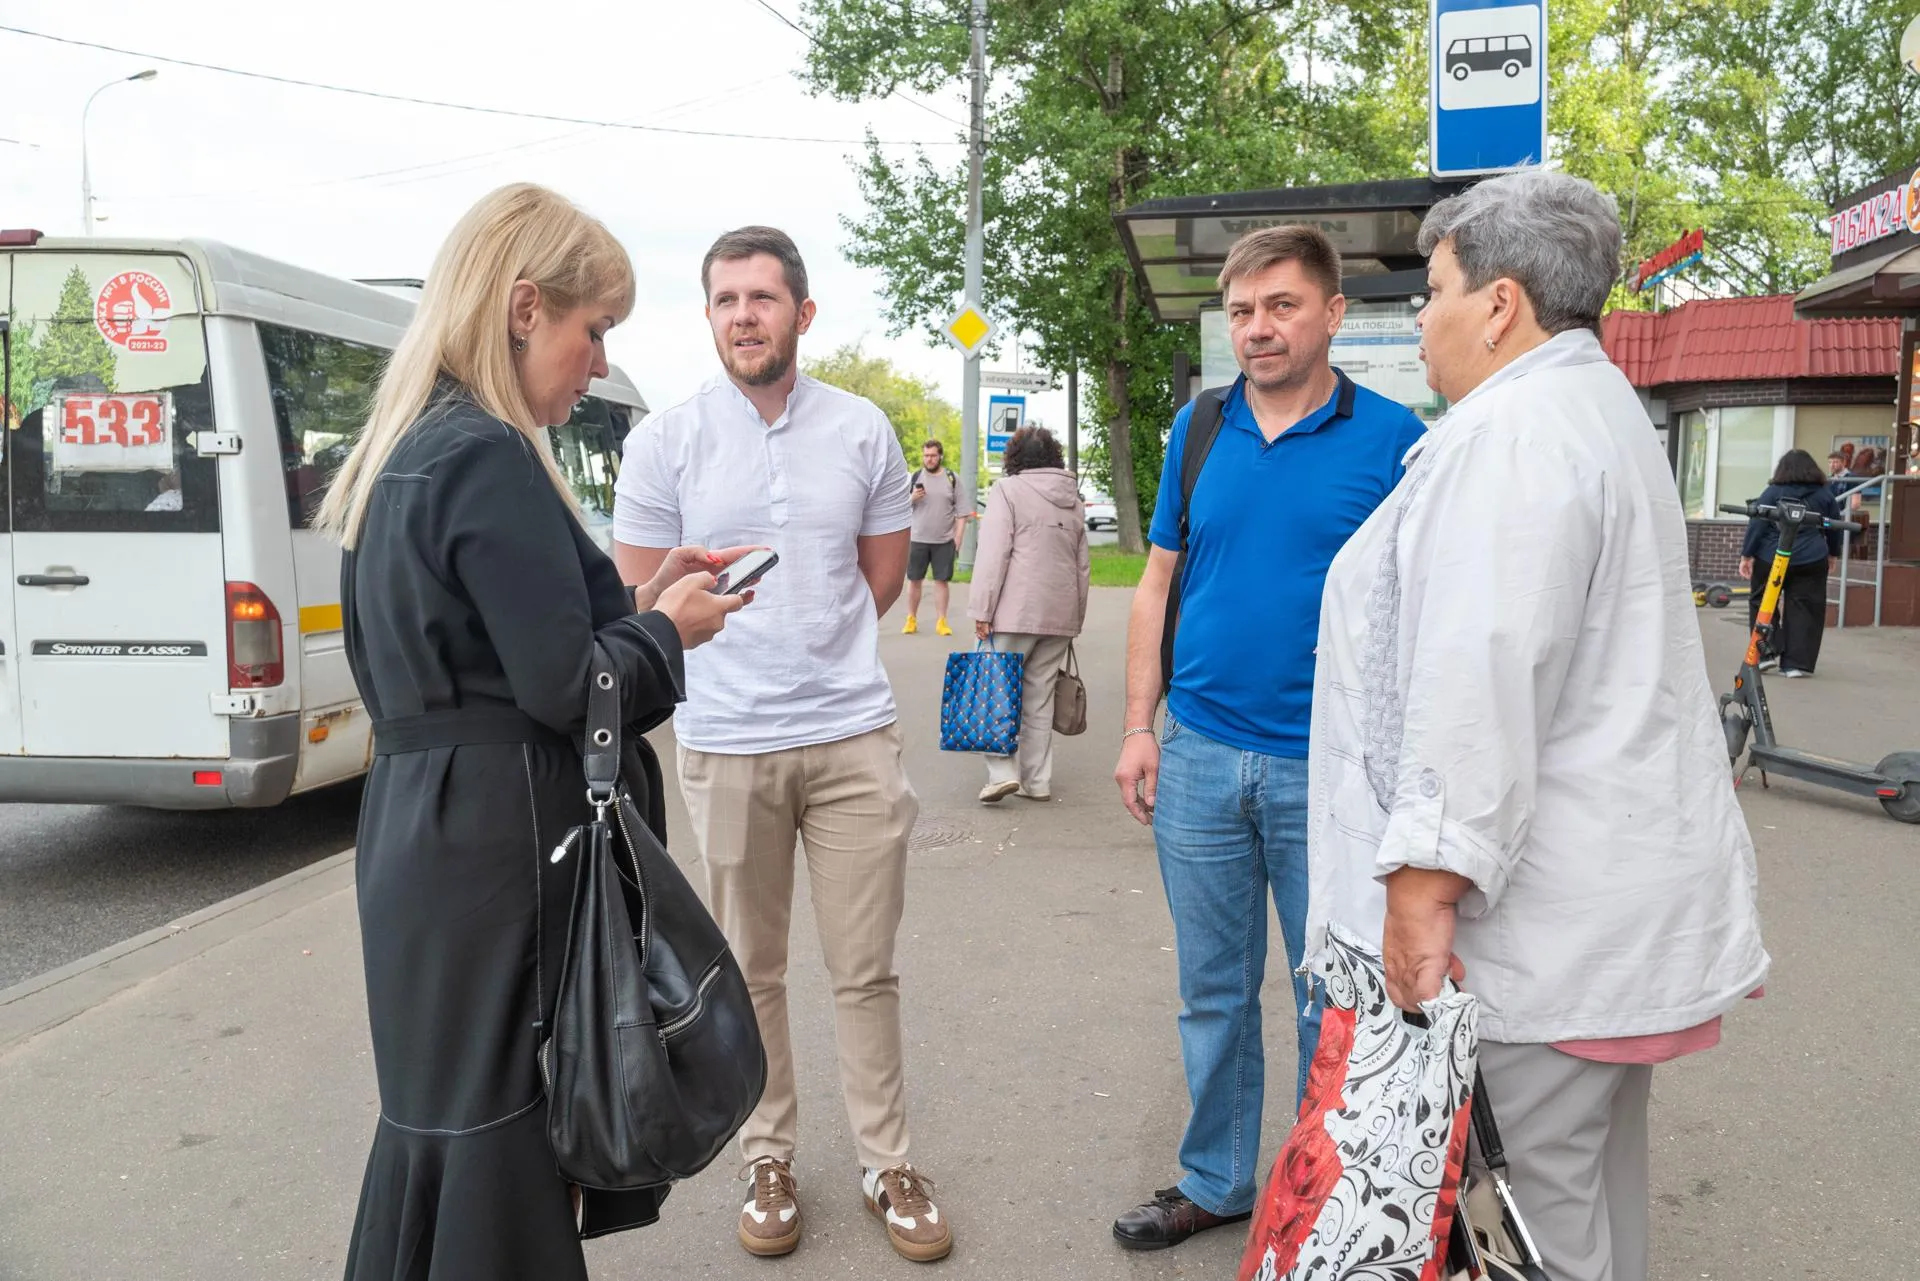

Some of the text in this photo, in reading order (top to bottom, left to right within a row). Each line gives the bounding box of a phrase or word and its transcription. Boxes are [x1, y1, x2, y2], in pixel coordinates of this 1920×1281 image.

[99, 301, 118, 338] МАРКА
[119, 275, 127, 285] В
[129, 273, 168, 303] РОССИИ
[1341, 320, 1404, 330] ИЦА ПОБЕДЫ
[64, 399, 161, 448] 533
[127, 645, 191, 656] CLASSIC
